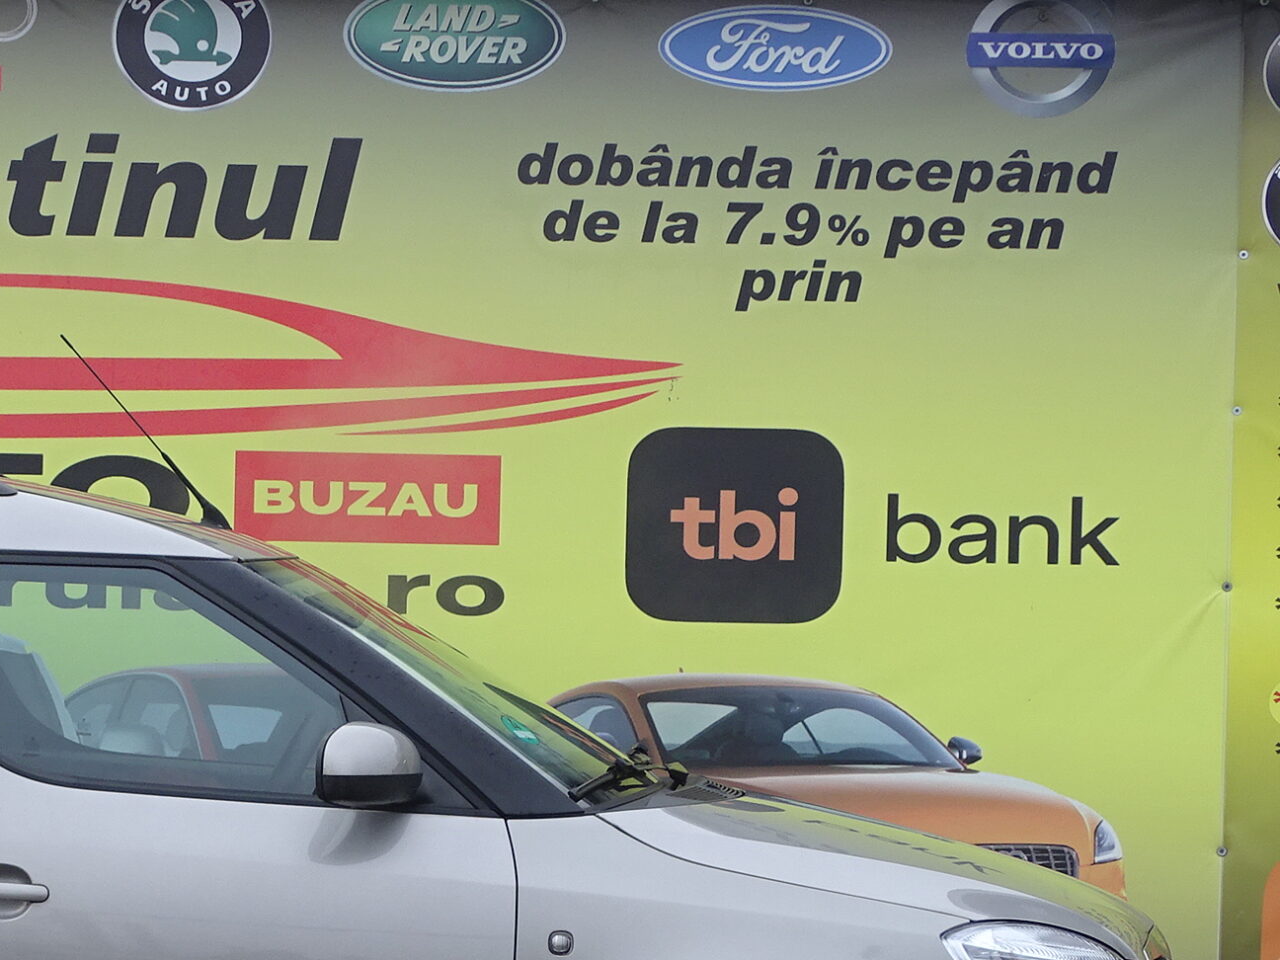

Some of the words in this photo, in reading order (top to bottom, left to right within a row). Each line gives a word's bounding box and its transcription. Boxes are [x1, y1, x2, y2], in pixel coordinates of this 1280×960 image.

[705, 18, 845, 74] Ford
[978, 41, 1104, 60] VOLVO
[151, 79, 231, 101] AUTO
[517, 142, 793, 188] dobânda
[815, 146, 1118, 203] începând
[542, 200, 620, 242] de
[641, 201, 699, 244] la
[724, 202, 870, 247] 7.9%
[883, 213, 965, 258] pe
[986, 217, 1065, 249] an
[735, 259, 863, 311] prin
[253, 479, 479, 518] BUZAU
[670, 487, 799, 560] tbi
[885, 493, 1120, 566] bank
